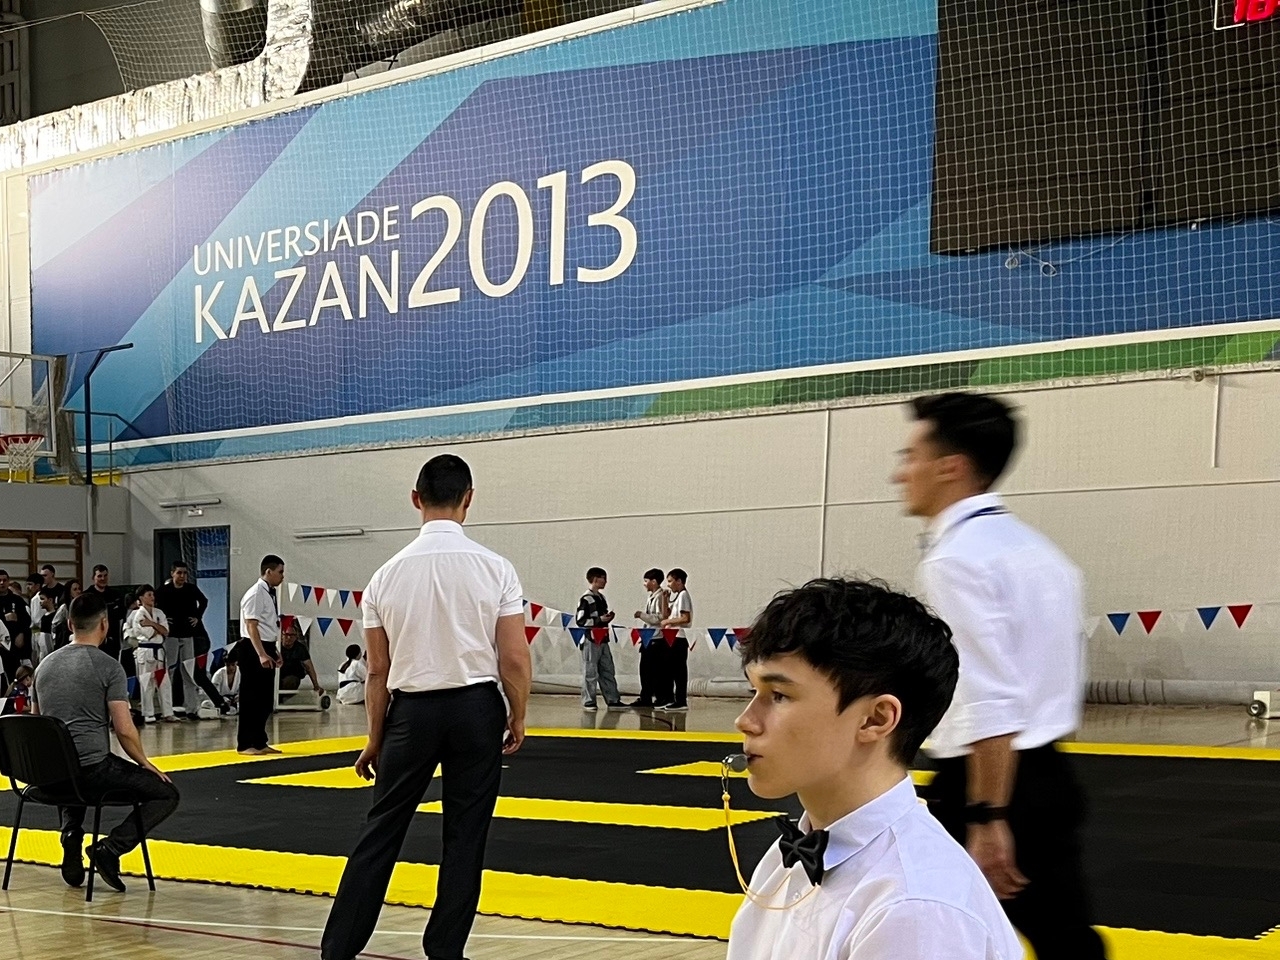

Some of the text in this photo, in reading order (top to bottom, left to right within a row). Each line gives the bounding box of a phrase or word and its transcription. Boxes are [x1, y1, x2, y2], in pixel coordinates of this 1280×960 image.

[193, 205, 400, 276] UNIVERSIADE
[194, 160, 638, 344] KAZAN 2013
